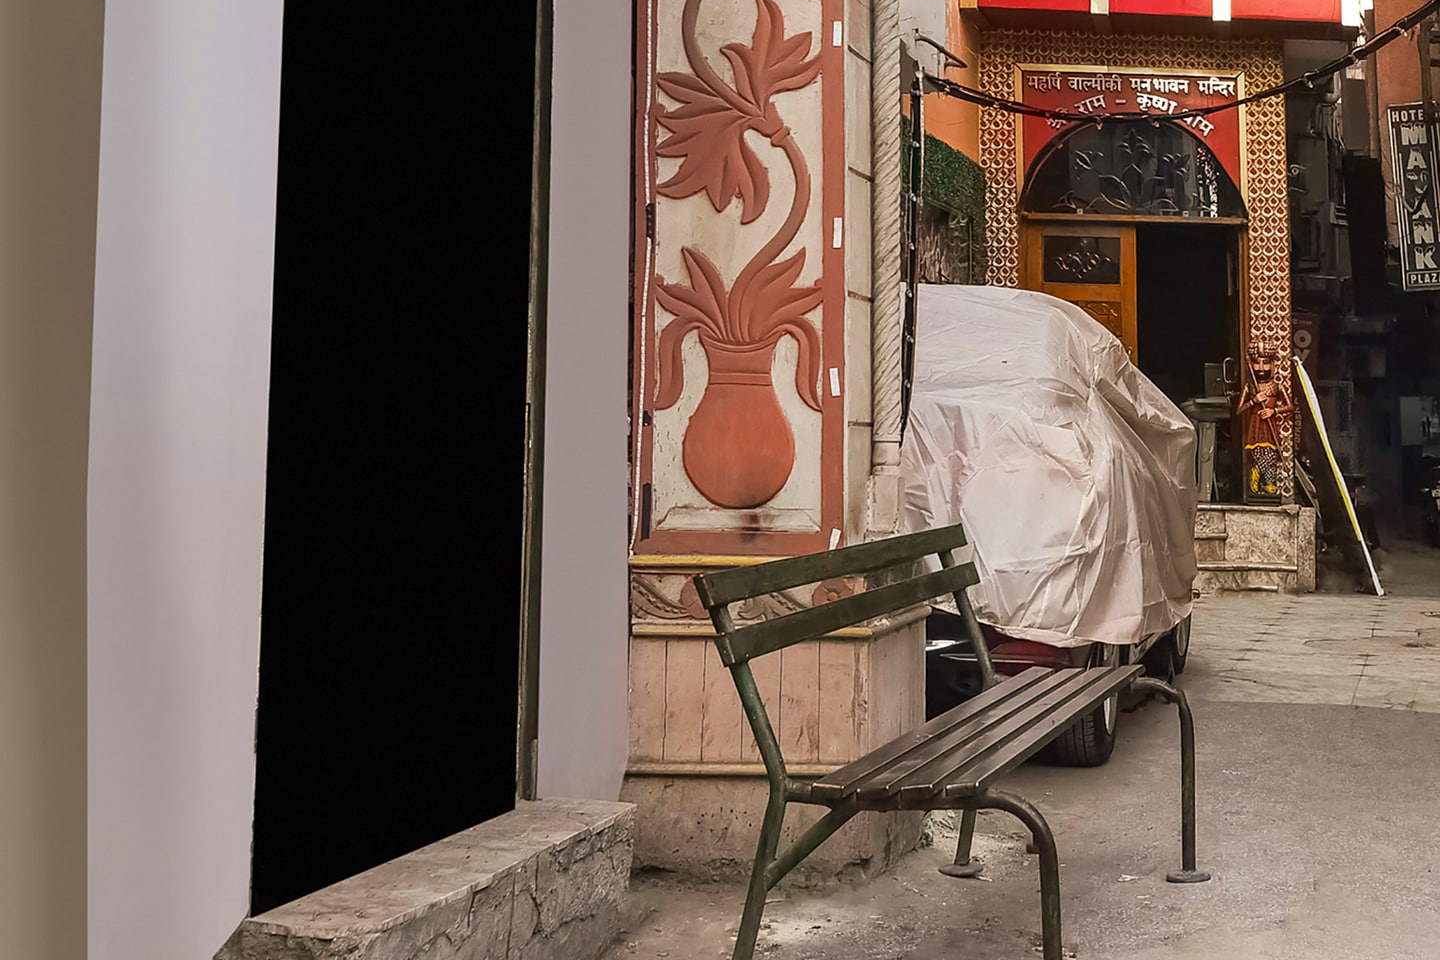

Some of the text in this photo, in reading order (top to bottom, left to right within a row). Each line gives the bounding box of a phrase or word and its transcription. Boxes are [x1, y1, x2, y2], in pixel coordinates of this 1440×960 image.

[1197, 77, 1236, 96] मन्दिर
[1074, 94, 1107, 115] राम
[1136, 91, 1177, 115] कृष्ण
[1391, 109, 1424, 123] HOTE
